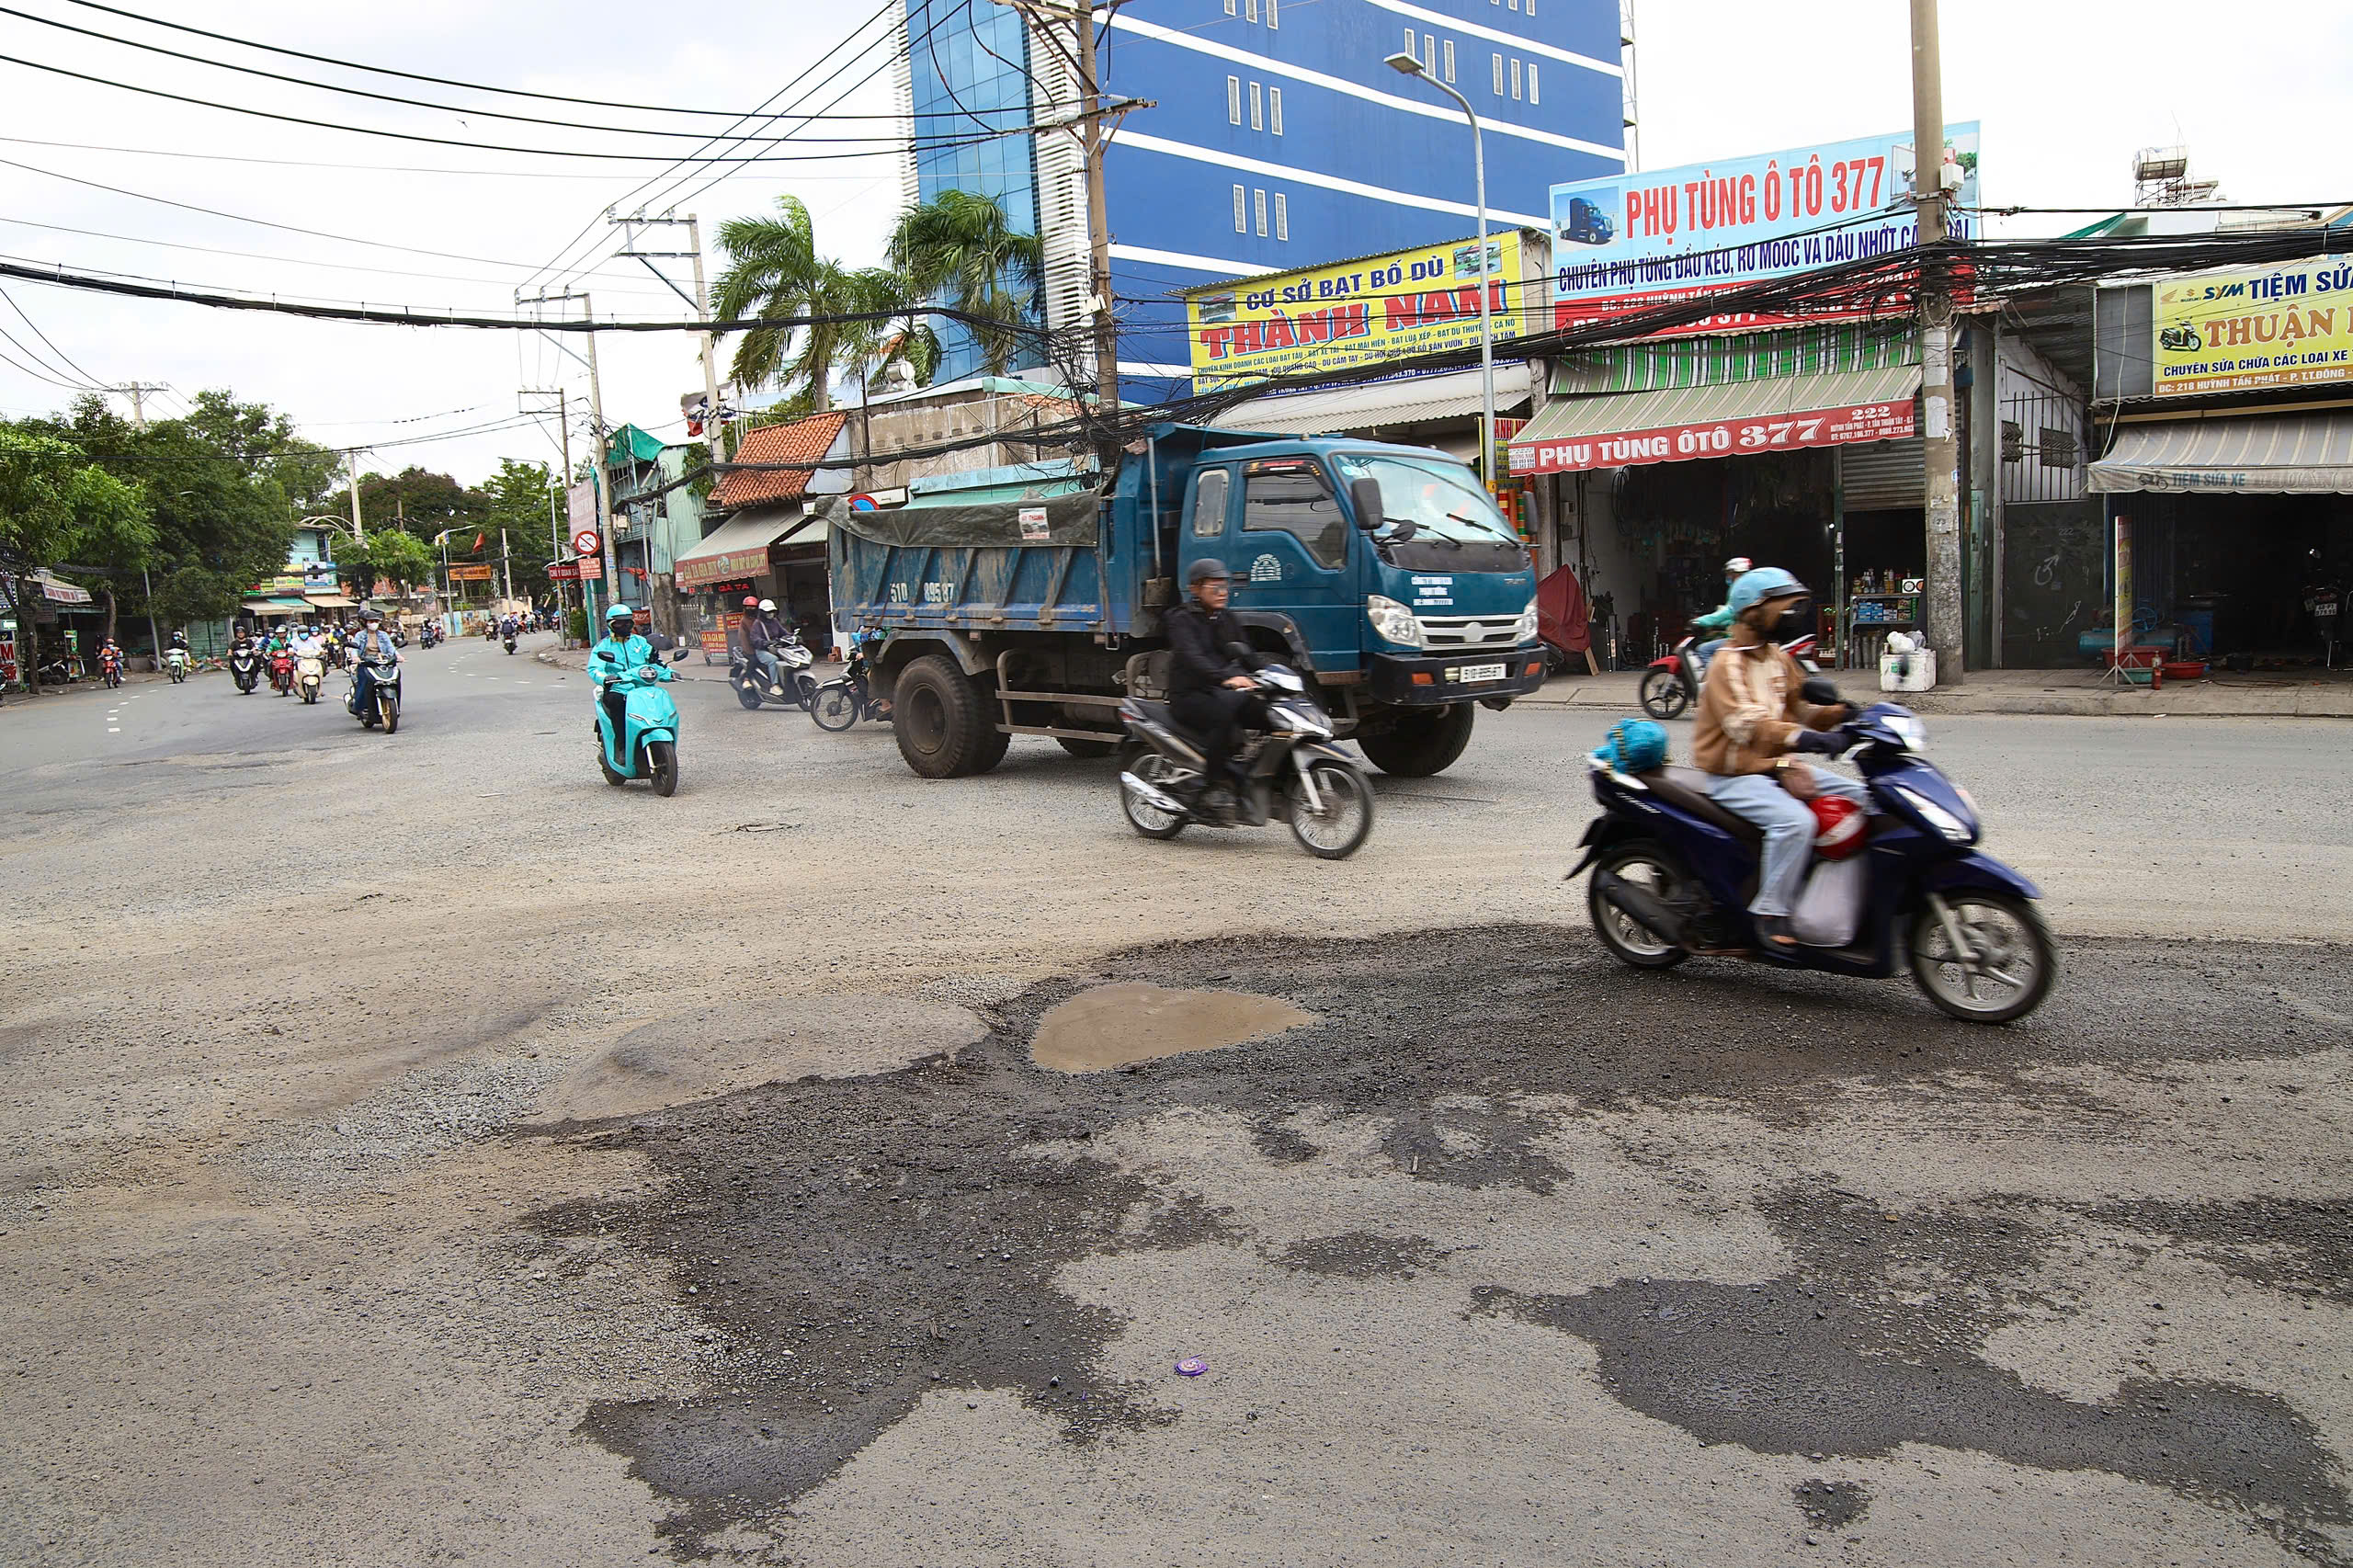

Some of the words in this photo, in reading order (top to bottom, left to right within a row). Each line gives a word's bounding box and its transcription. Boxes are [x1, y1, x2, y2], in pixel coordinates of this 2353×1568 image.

[1626, 185, 1677, 245] PHỤ
[1684, 169, 1756, 232] TÙNG
[1764, 160, 1781, 222] Ô
[1789, 153, 1823, 218] TÔ
[1831, 156, 1885, 213] 377
[1559, 259, 1608, 292] CHUYÊN
[1610, 257, 1636, 290] PHỤ
[1638, 252, 1672, 283] TÙNG
[1759, 239, 1801, 270] MOOC
[1803, 233, 1822, 265] VÀ
[1900, 219, 1920, 251] CÁ
[1246, 288, 1276, 311] CƠ
[1282, 278, 1313, 304] SỞ
[1319, 274, 1363, 301] BẠT
[1370, 258, 1404, 290] BỐ
[1411, 255, 1444, 282] DÙ
[2202, 282, 2245, 301] SYM
[2248, 272, 2307, 301] TIỆM
[1199, 302, 1370, 360] THÀNH
[1384, 278, 1508, 332] NAM
[2204, 303, 2336, 348] THUẬN
[2164, 361, 2208, 377] CHUYÊN
[2211, 358, 2234, 372] SỬA
[2238, 355, 2270, 369] CHỮA
[2273, 353, 2298, 367] CÁC
[2301, 351, 2328, 366] LOẠI
[2333, 349, 2348, 361] XE
[2177, 381, 2195, 392] 218
[2197, 377, 2230, 390] HUỲNH
[2233, 374, 2252, 387] TẤN
[2255, 372, 2280, 385] PHÁT
[1851, 405, 1892, 421] 222
[1539, 443, 1592, 468] PHỤ
[1597, 436, 1671, 461] TÙNG
[1677, 426, 1733, 454] ÔTÔ
[1738, 416, 1826, 448] 377
[2230, 472, 2246, 486] XE
